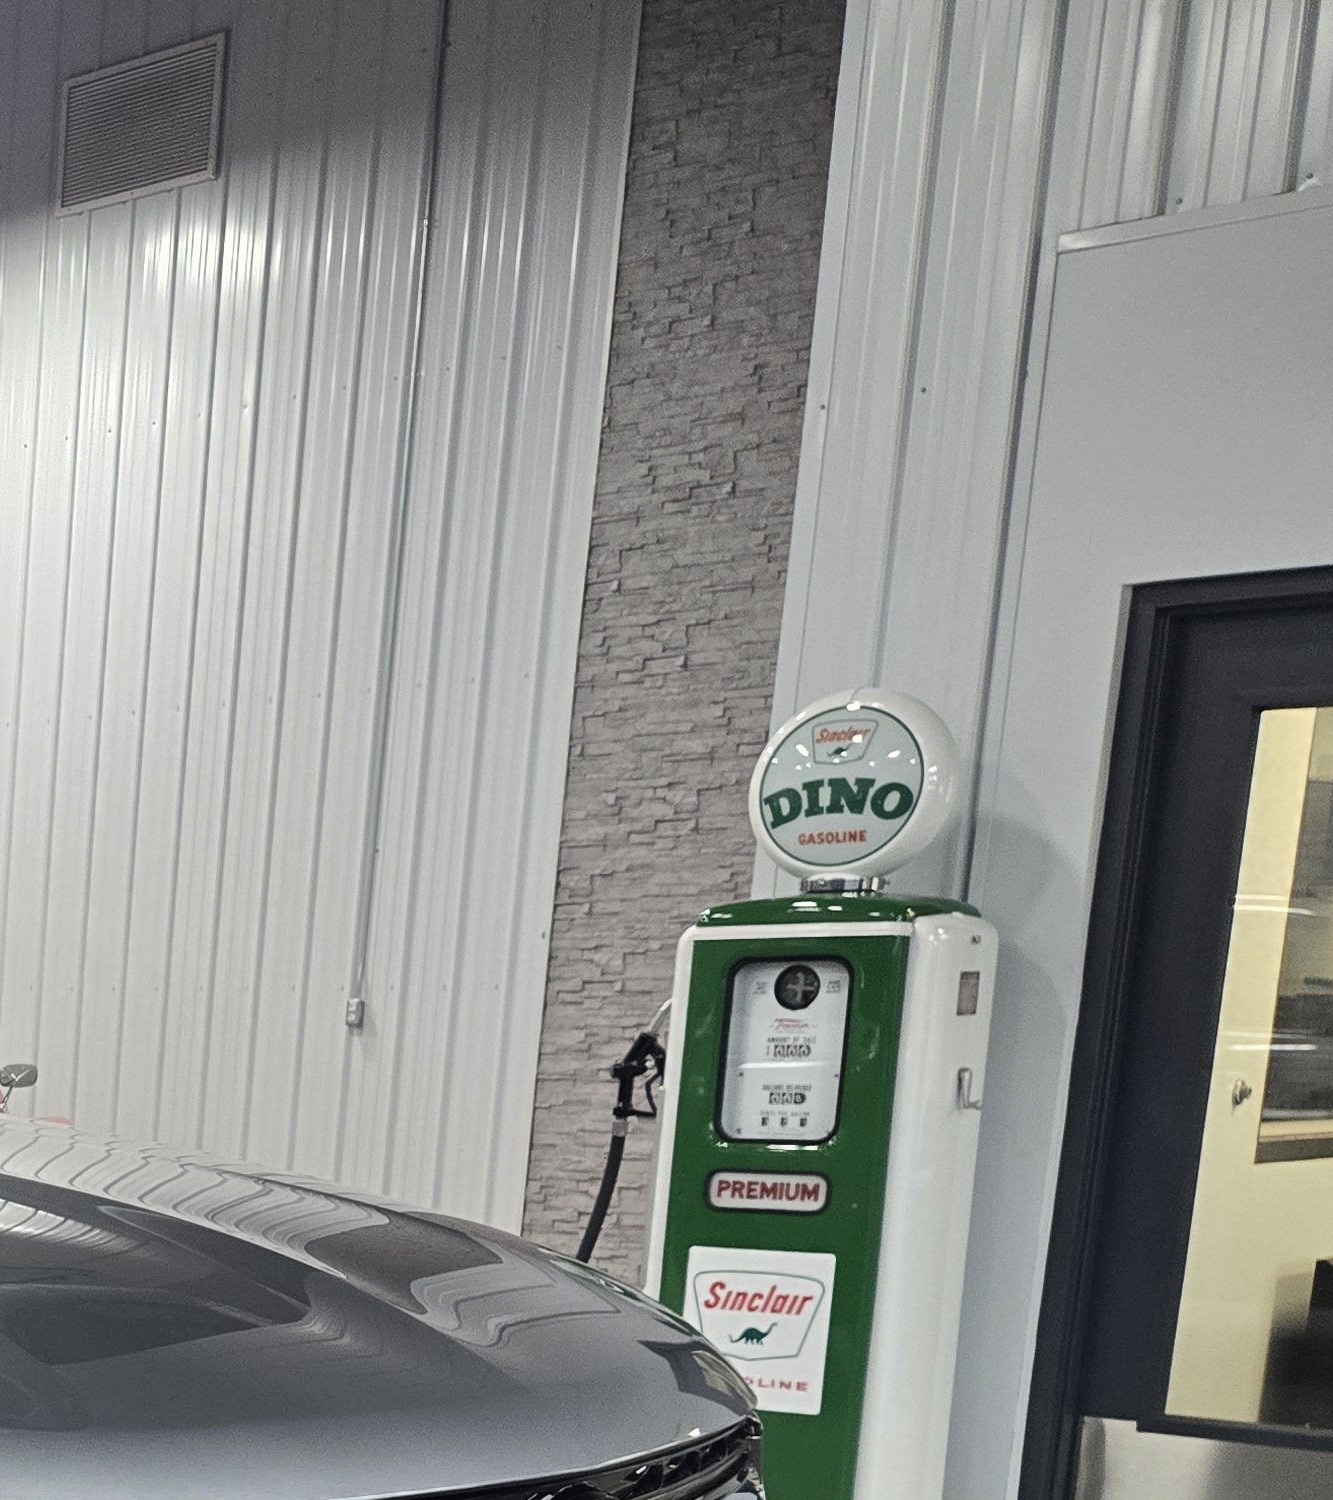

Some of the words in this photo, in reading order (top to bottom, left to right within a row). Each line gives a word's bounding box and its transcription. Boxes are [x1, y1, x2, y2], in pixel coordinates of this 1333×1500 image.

[764, 777, 914, 830] DINO
[798, 829, 867, 845] GASOLINE
[717, 1180, 821, 1203] PREMIUM
[704, 1281, 814, 1316] Sinclair
